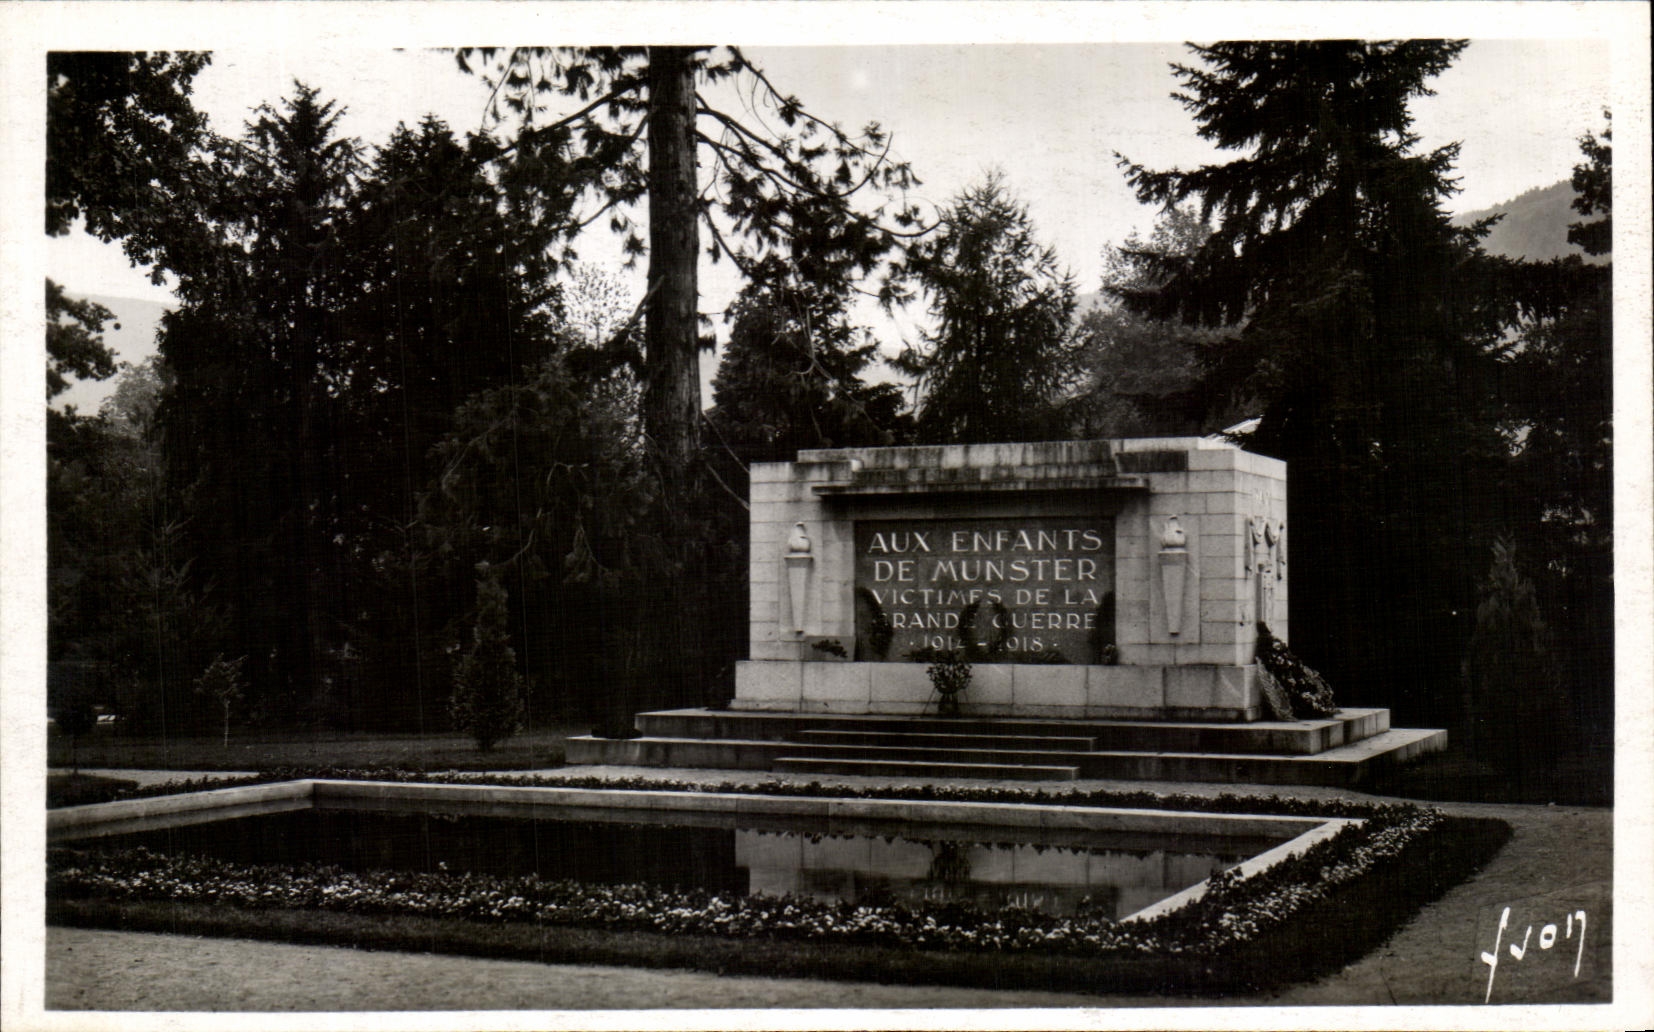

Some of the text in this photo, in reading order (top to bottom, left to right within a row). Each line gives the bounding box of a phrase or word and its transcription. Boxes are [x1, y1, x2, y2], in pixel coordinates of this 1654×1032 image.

[868, 530, 1102, 553] AUX ENFANTS
[874, 558, 1097, 581] DE MUNSTER
[871, 588, 1098, 605] VICTIMES DE LA
[873, 612, 977, 629] RAND
[998, 636, 1044, 652] 918
